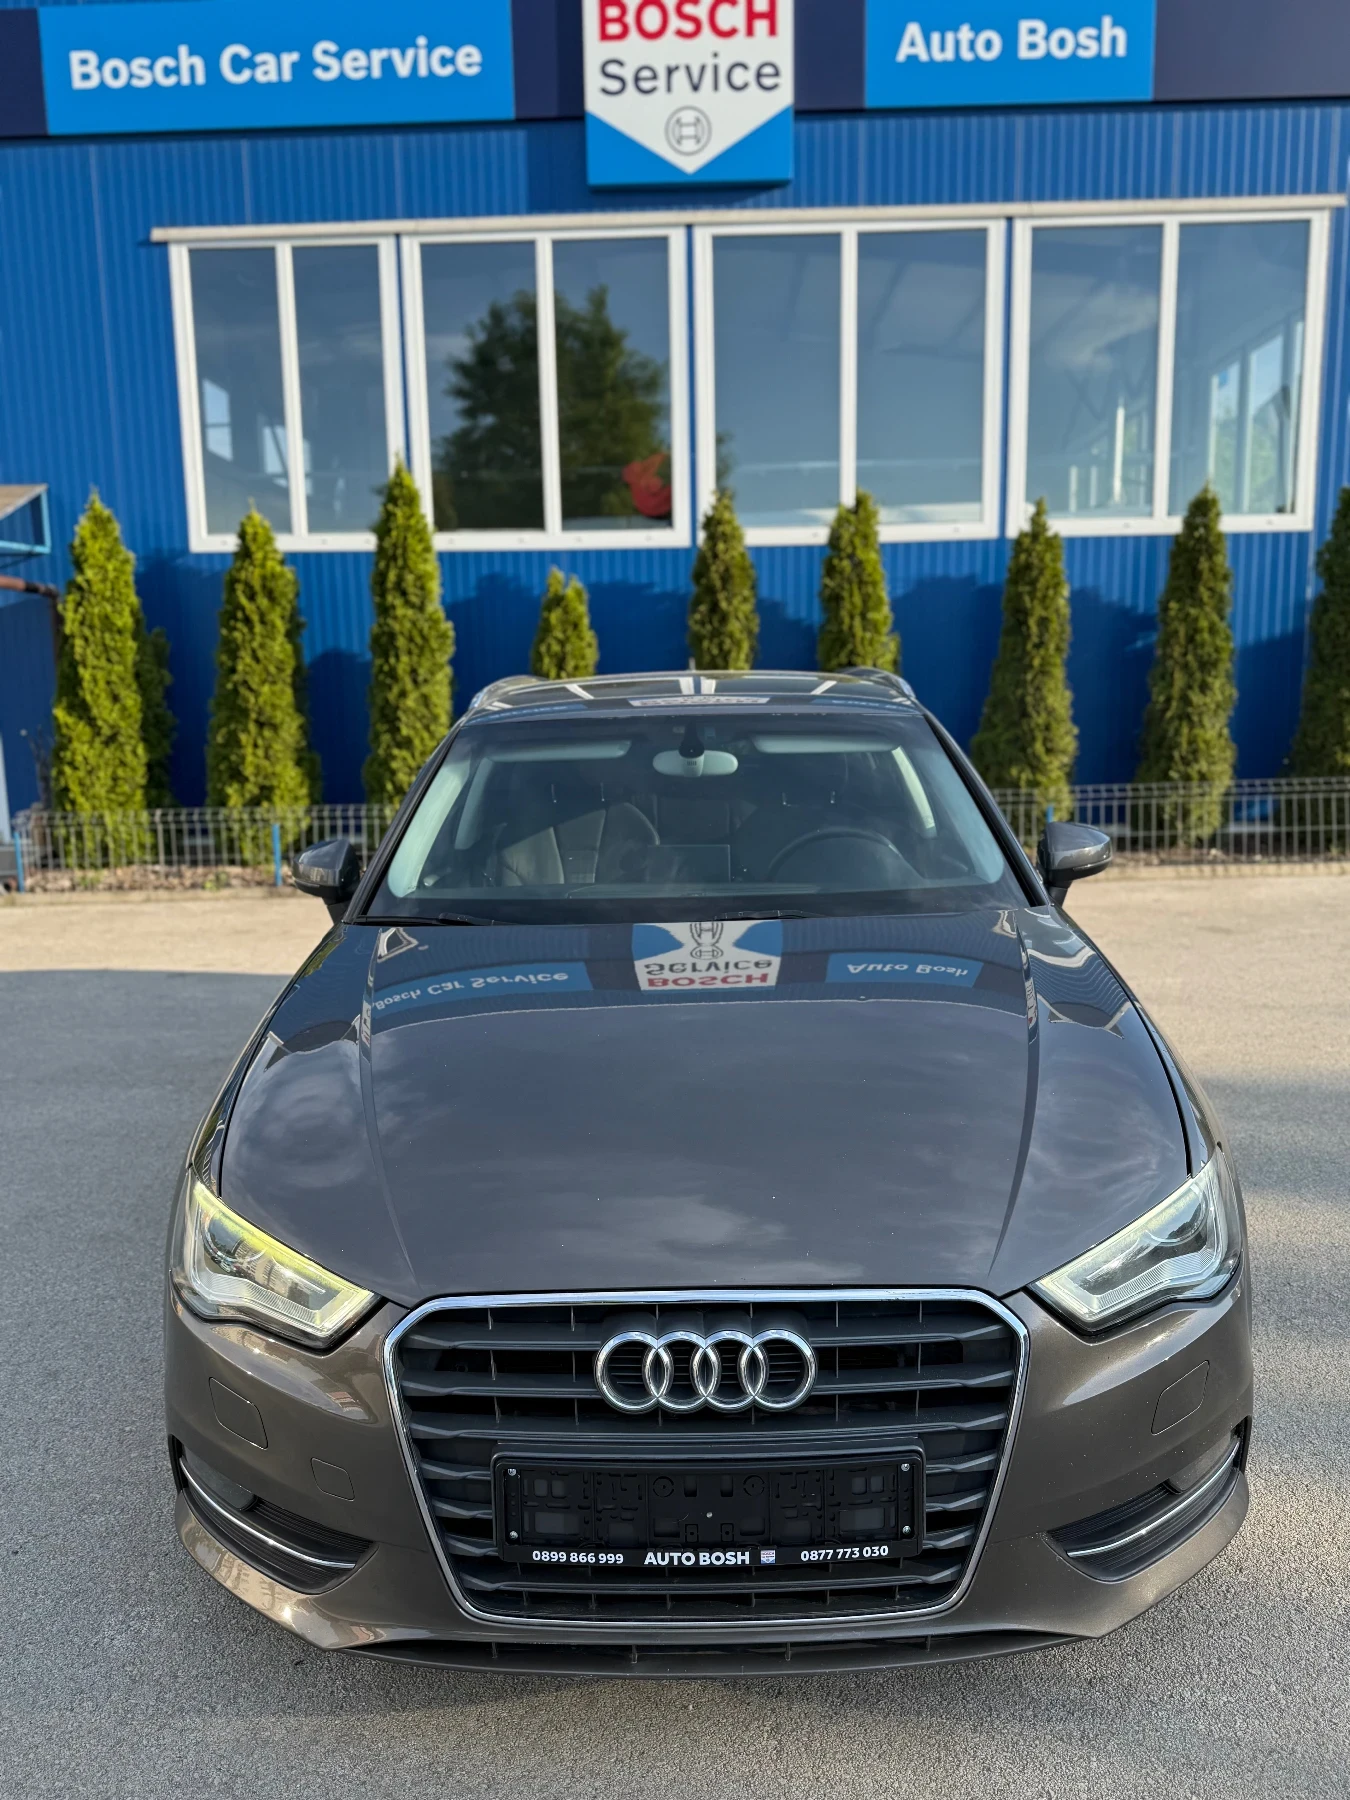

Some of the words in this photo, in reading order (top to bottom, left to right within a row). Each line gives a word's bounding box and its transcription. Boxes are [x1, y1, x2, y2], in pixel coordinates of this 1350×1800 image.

[599, 0, 777, 42] BOSCH
[896, 22, 1002, 62] Auto
[1016, 15, 1127, 60] Bosh
[68, 45, 206, 90] Bosch
[219, 44, 300, 84] Car
[311, 36, 482, 82] Service
[599, 52, 781, 96] Service
[532, 1550, 567, 1563] 0899
[569, 1552, 596, 1563] 866
[598, 1553, 624, 1564] 999
[643, 1551, 696, 1566] AUTO
[698, 1551, 750, 1566] BOSH
[800, 1549, 834, 1561] 0877
[835, 1547, 860, 1559] 773
[862, 1545, 889, 1557] 030
